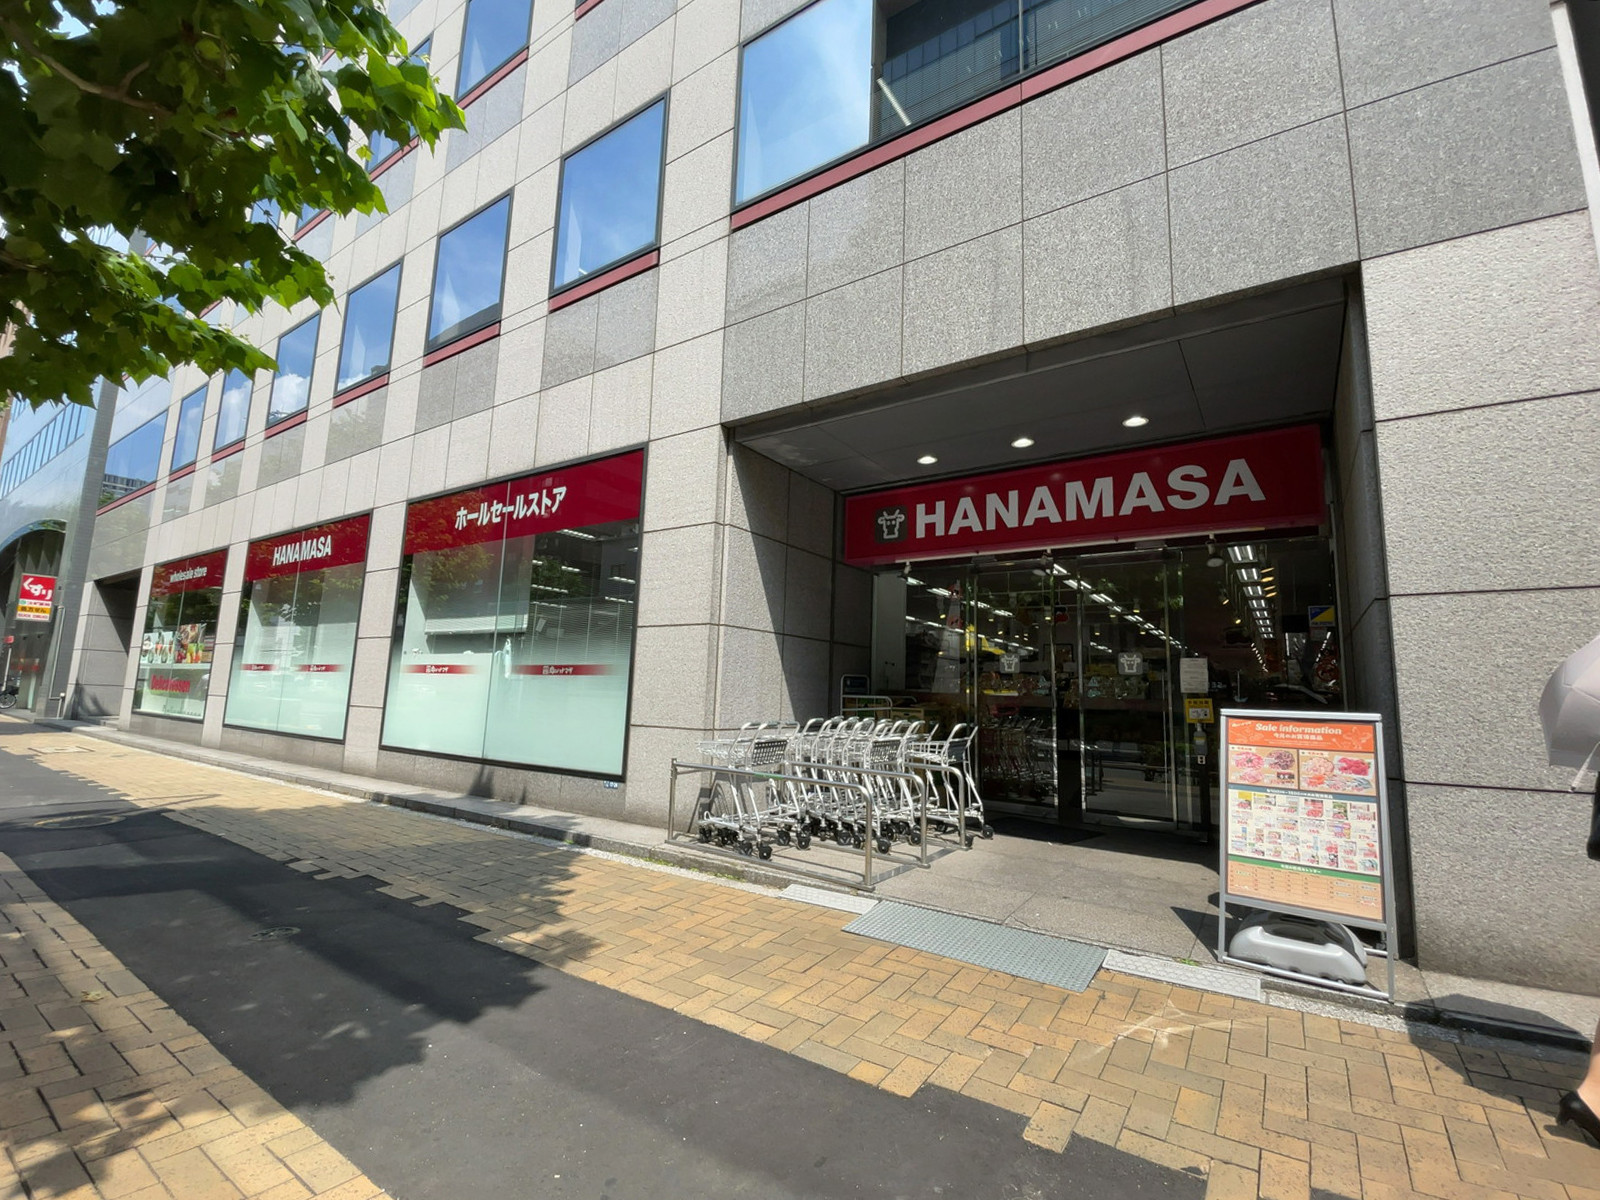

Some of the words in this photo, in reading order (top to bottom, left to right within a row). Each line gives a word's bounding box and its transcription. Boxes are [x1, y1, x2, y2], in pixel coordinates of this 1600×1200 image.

[454, 486, 567, 531] ホールセールストア
[915, 457, 1266, 539] HANAMASA
[272, 535, 332, 566] HANAMASA
[169, 567, 193, 583] wholesale
[194, 565, 208, 577] store
[23, 577, 53, 600] くすり
[1255, 723, 1278, 732] Sale
[1279, 724, 1342, 735] information
